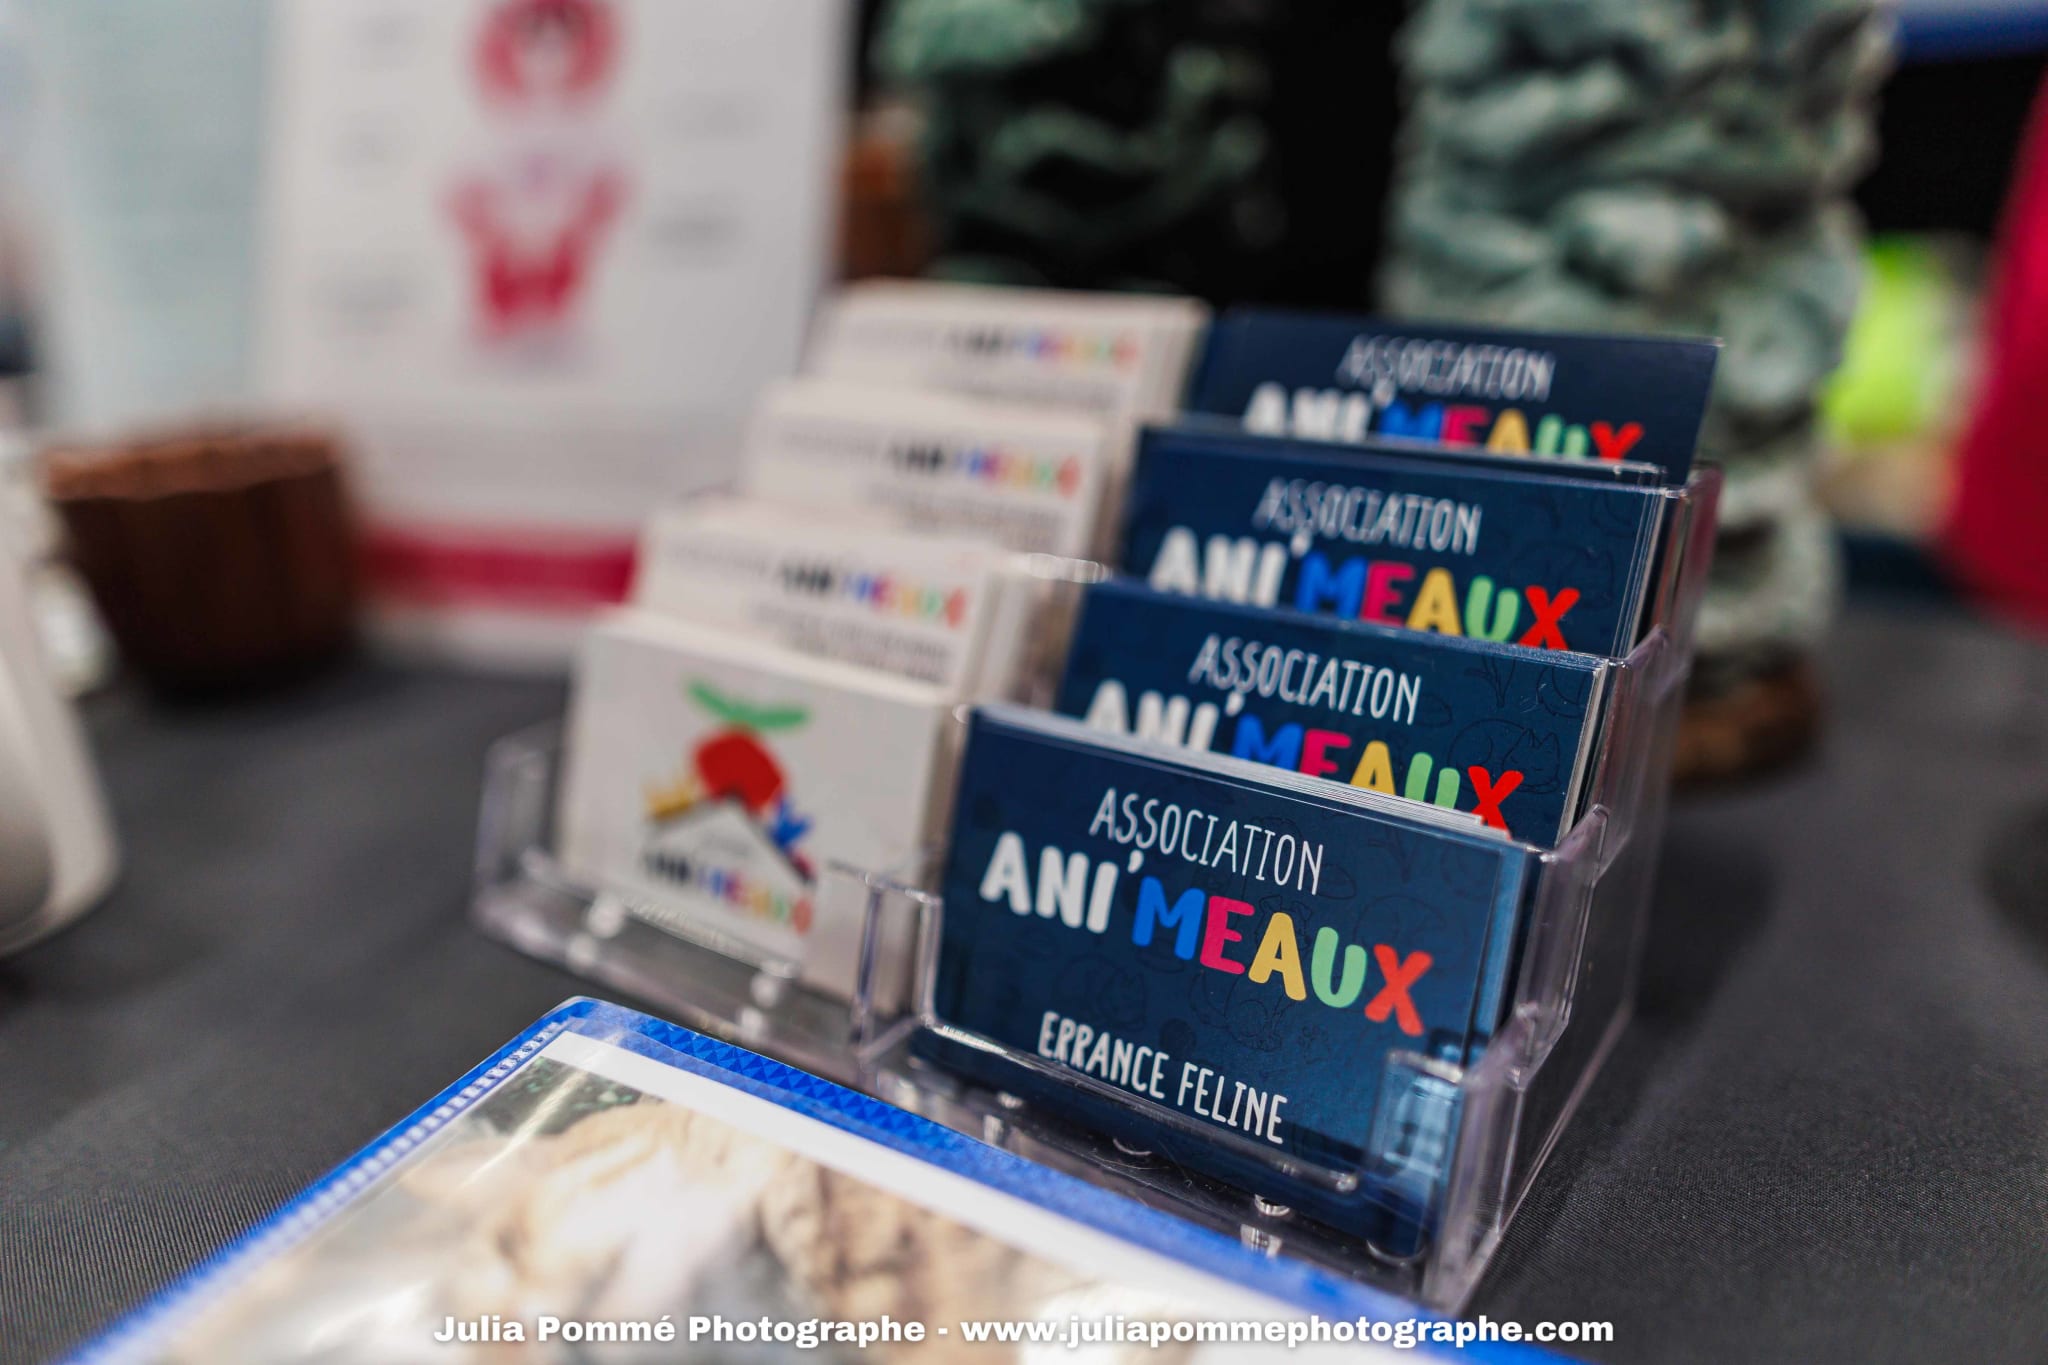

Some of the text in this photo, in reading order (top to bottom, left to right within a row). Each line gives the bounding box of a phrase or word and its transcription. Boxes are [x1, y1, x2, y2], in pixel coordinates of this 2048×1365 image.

[1336, 334, 1555, 401] ASSOCIATION
[1253, 477, 1482, 555] ASSOCIATION
[1189, 633, 1422, 726] ASSOCIATION
[1089, 787, 1324, 895] ASSOCIATION
[980, 832, 1433, 1036] ANI'MEAUX
[1038, 1010, 1288, 1145] ERRANCE FELINE
